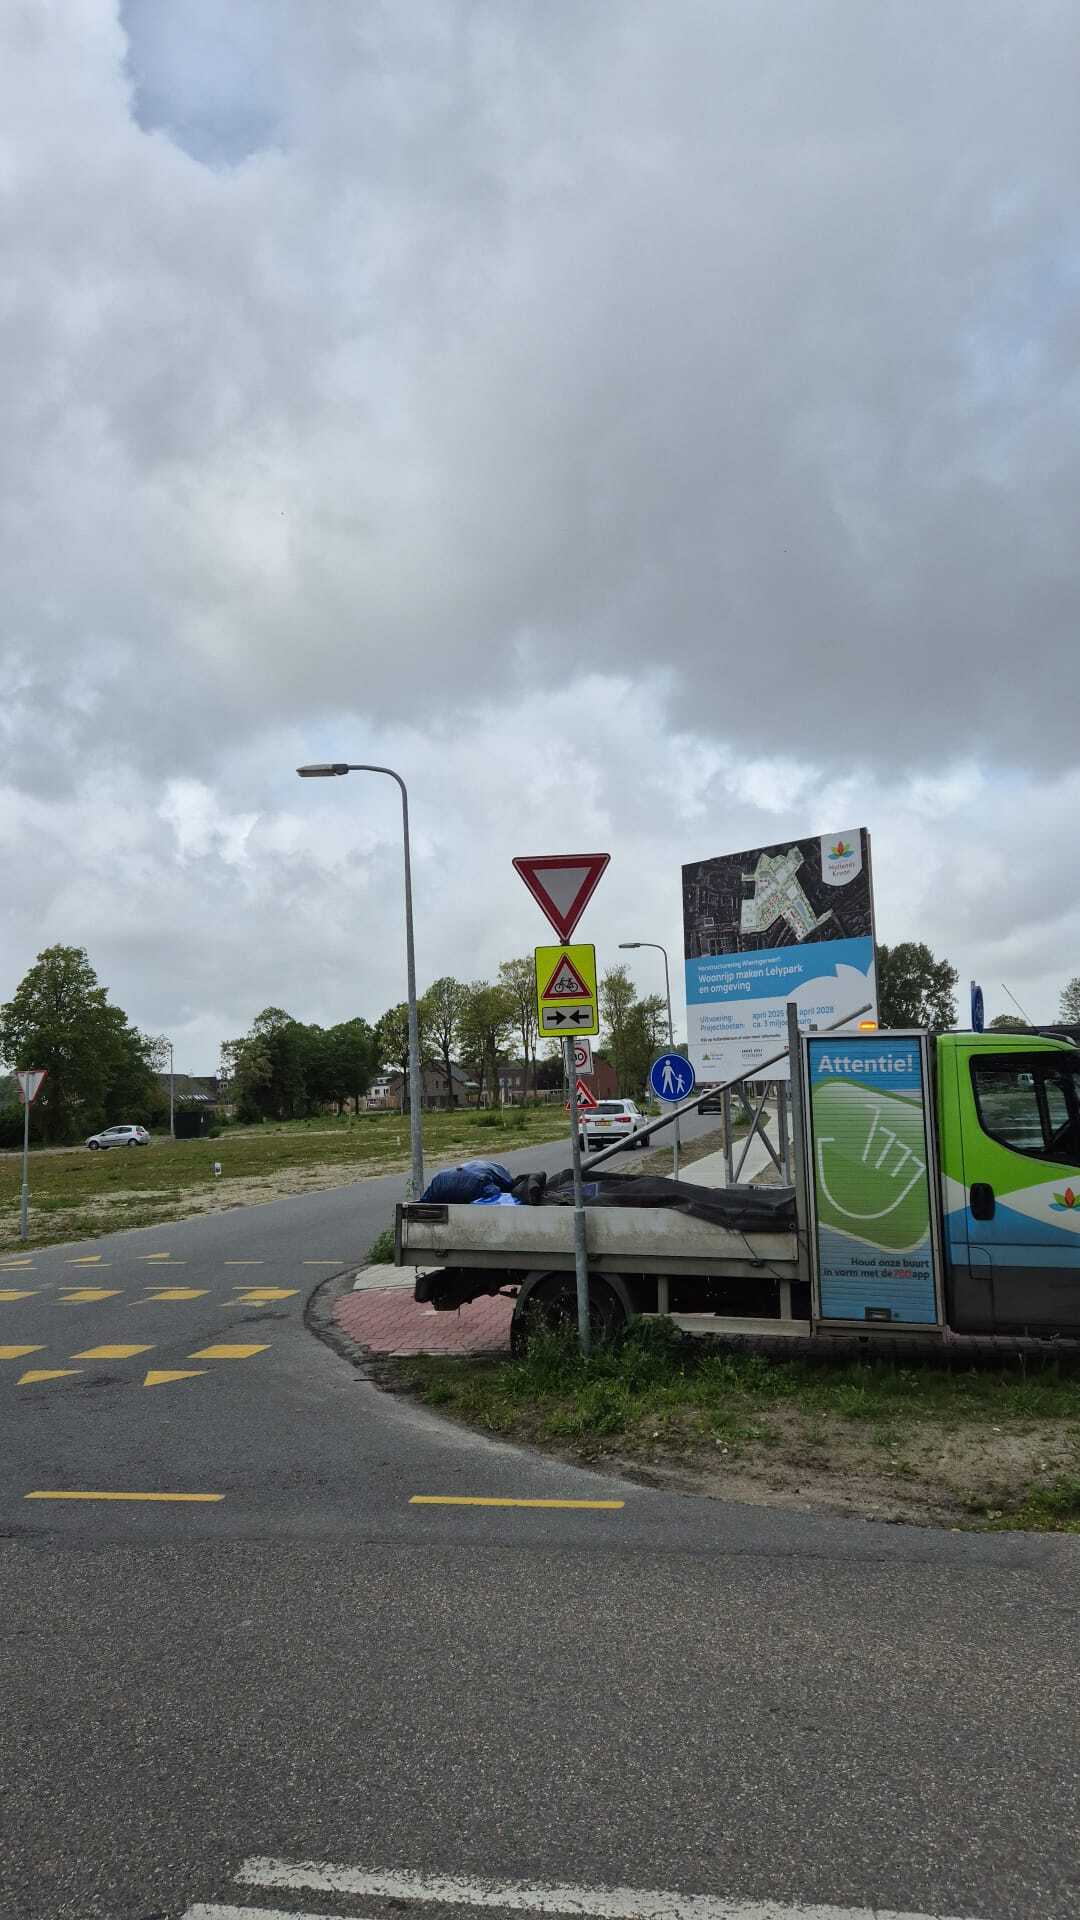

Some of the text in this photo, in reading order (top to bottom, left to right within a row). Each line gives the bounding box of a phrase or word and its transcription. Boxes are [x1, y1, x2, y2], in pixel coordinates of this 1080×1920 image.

[698, 964, 802, 984] Woonrijp maken Lelypark
[699, 981, 751, 994] en omgeving
[818, 1054, 913, 1073] Attentie!
[851, 1257, 930, 1268] Houd onze buurt
[834, 1269, 858, 1277] vorm
[860, 1268, 878, 1278] met
[880, 1269, 893, 1278] de
[912, 1271, 930, 1281] app
